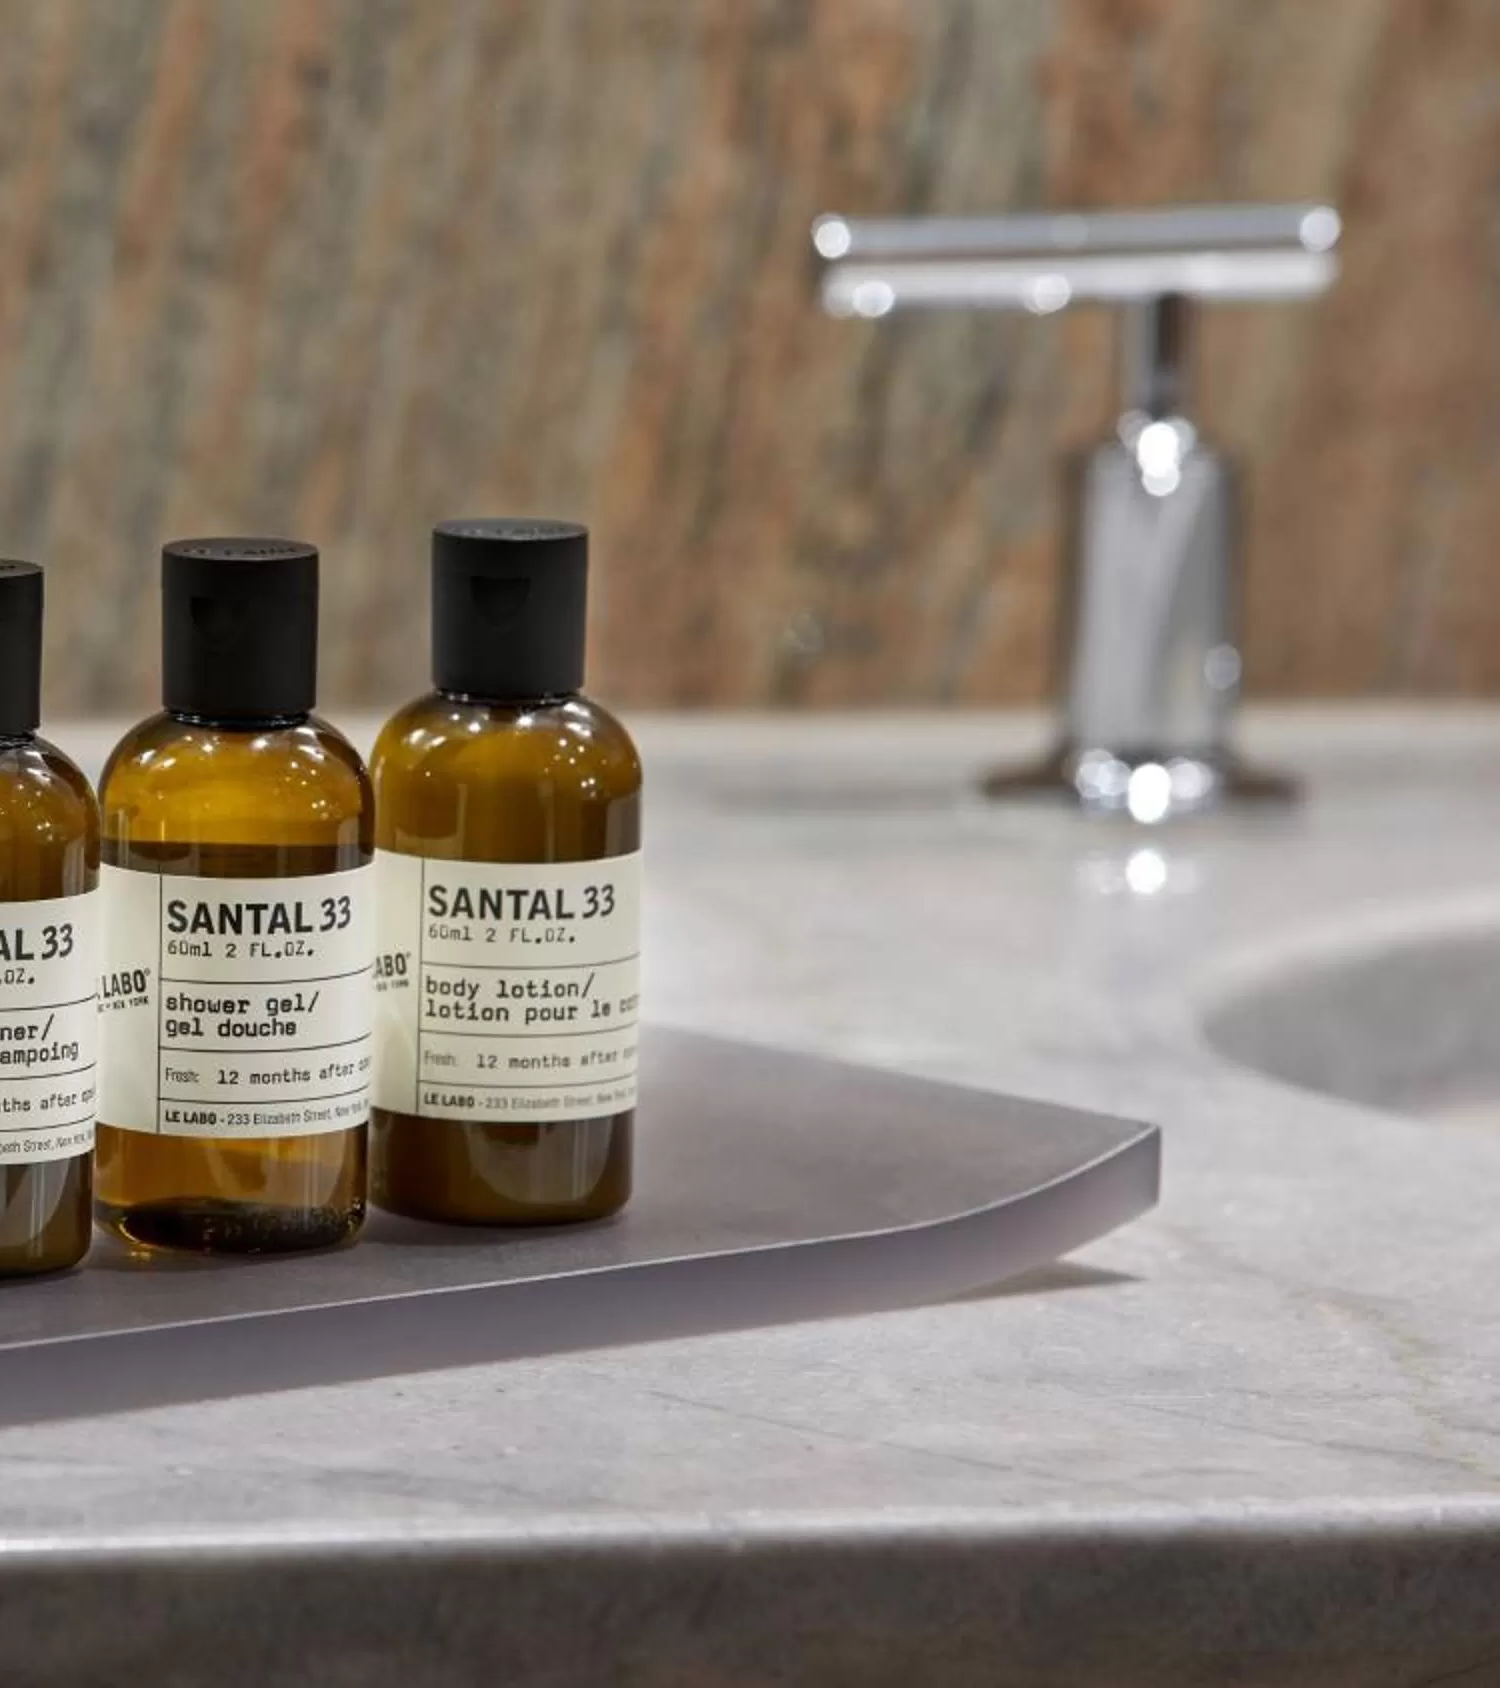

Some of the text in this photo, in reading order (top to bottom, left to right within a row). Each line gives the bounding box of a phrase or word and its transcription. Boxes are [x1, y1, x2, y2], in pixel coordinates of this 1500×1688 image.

[428, 884, 615, 921] SANTAL 33
[167, 896, 351, 935] SANTAL 33
[42, 923, 74, 960] 33
[428, 925, 576, 944] 60ml 2 FL.OZ.
[167, 940, 315, 958] 60ml 2 FL.OZ.
[426, 973, 595, 1000] body lotion/
[165, 991, 320, 1016] shower gel/
[425, 1000, 509, 1020] lotion
[525, 1005, 578, 1026] pour
[591, 1000, 611, 1017] le
[165, 1017, 297, 1038] gel douche
[476, 1054, 498, 1069] 12
[509, 1053, 570, 1068] months
[580, 1050, 617, 1065] after
[165, 1067, 199, 1083] Fresh:
[217, 1070, 239, 1085] 12
[250, 1068, 311, 1085] months
[319, 1064, 354, 1080] after
[40, 1093, 78, 1110] after
[424, 1094, 441, 1106] LE
[442, 1095, 474, 1108] LABO
[165, 1111, 182, 1123] LE
[183, 1111, 216, 1125] LABO
[227, 1113, 250, 1126] 233
[254, 1110, 300, 1125] Elizabeth
